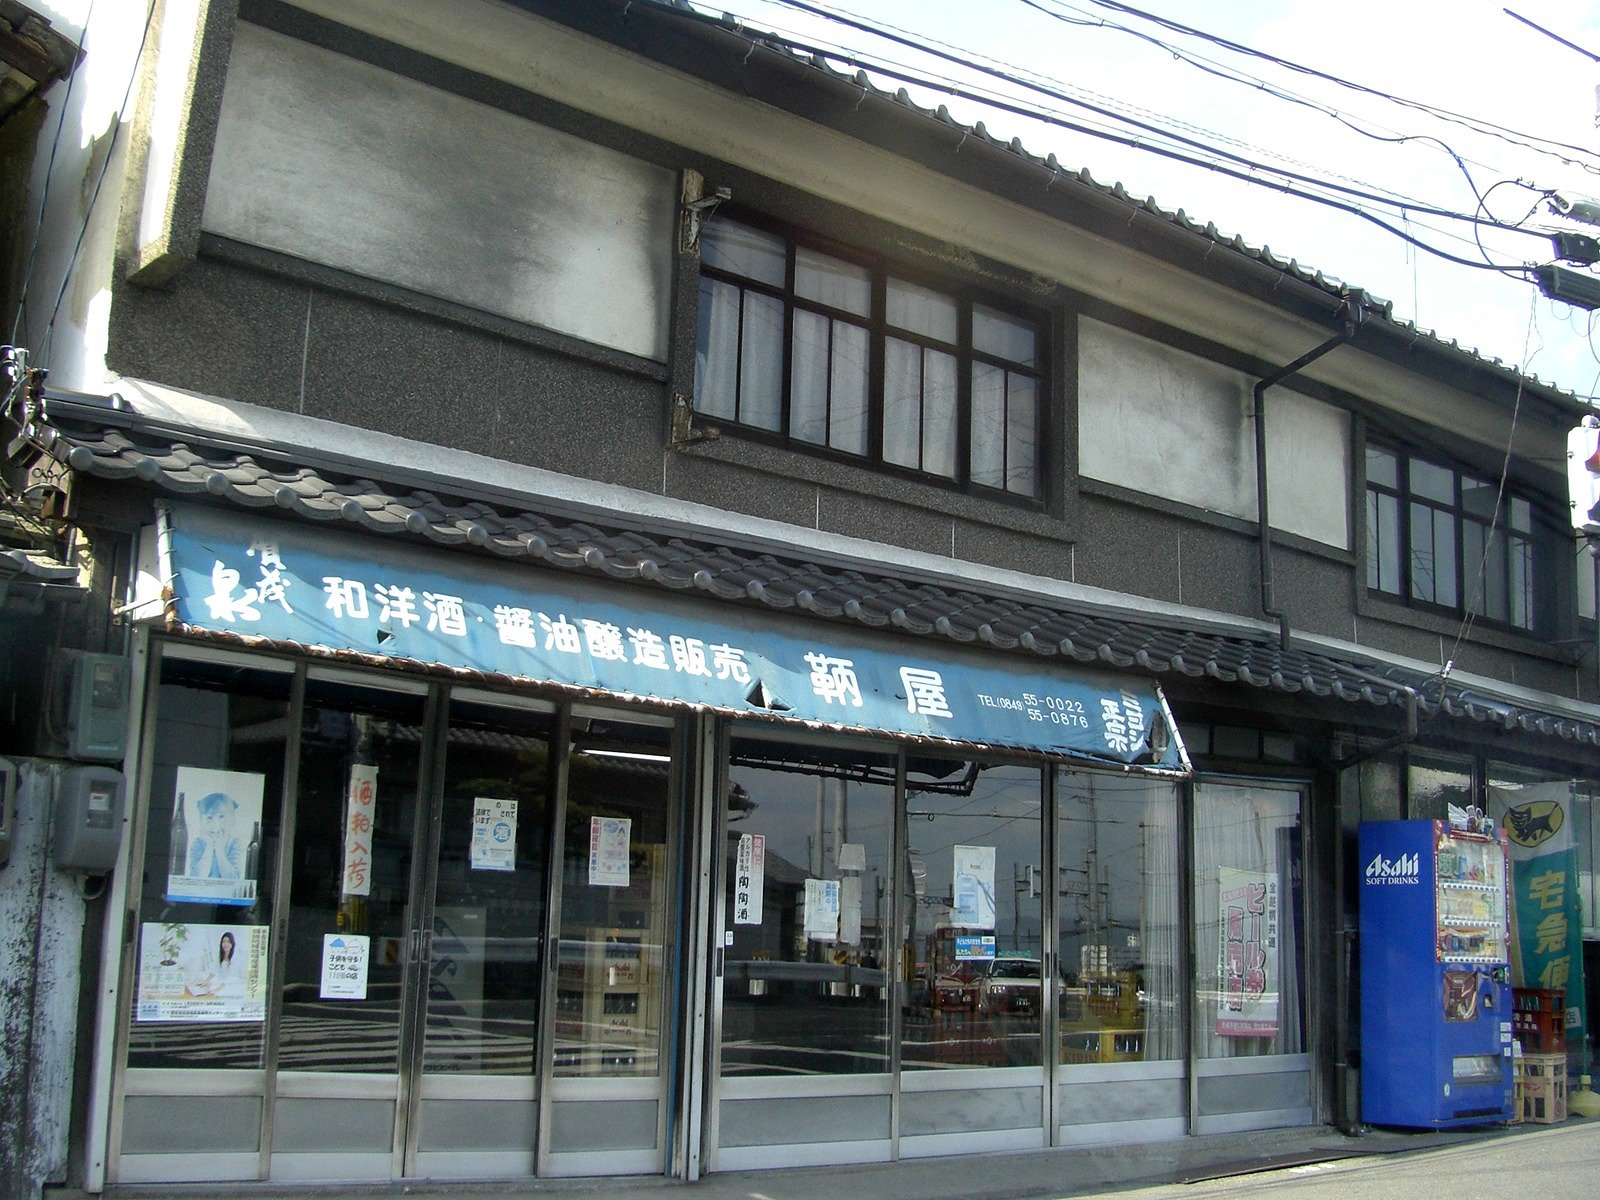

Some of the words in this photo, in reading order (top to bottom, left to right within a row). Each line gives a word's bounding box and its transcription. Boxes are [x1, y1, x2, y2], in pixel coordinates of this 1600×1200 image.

[203, 559, 262, 622] 泉
[1022, 693, 1085, 713] 55-0022
[1027, 708, 1089, 728] 55-0876
[1366, 852, 1419, 877] Asahi
[1366, 877, 1387, 885] SOFT
[1388, 876, 1419, 885] DRINKS
[1528, 869, 1571, 990] 宅急便
